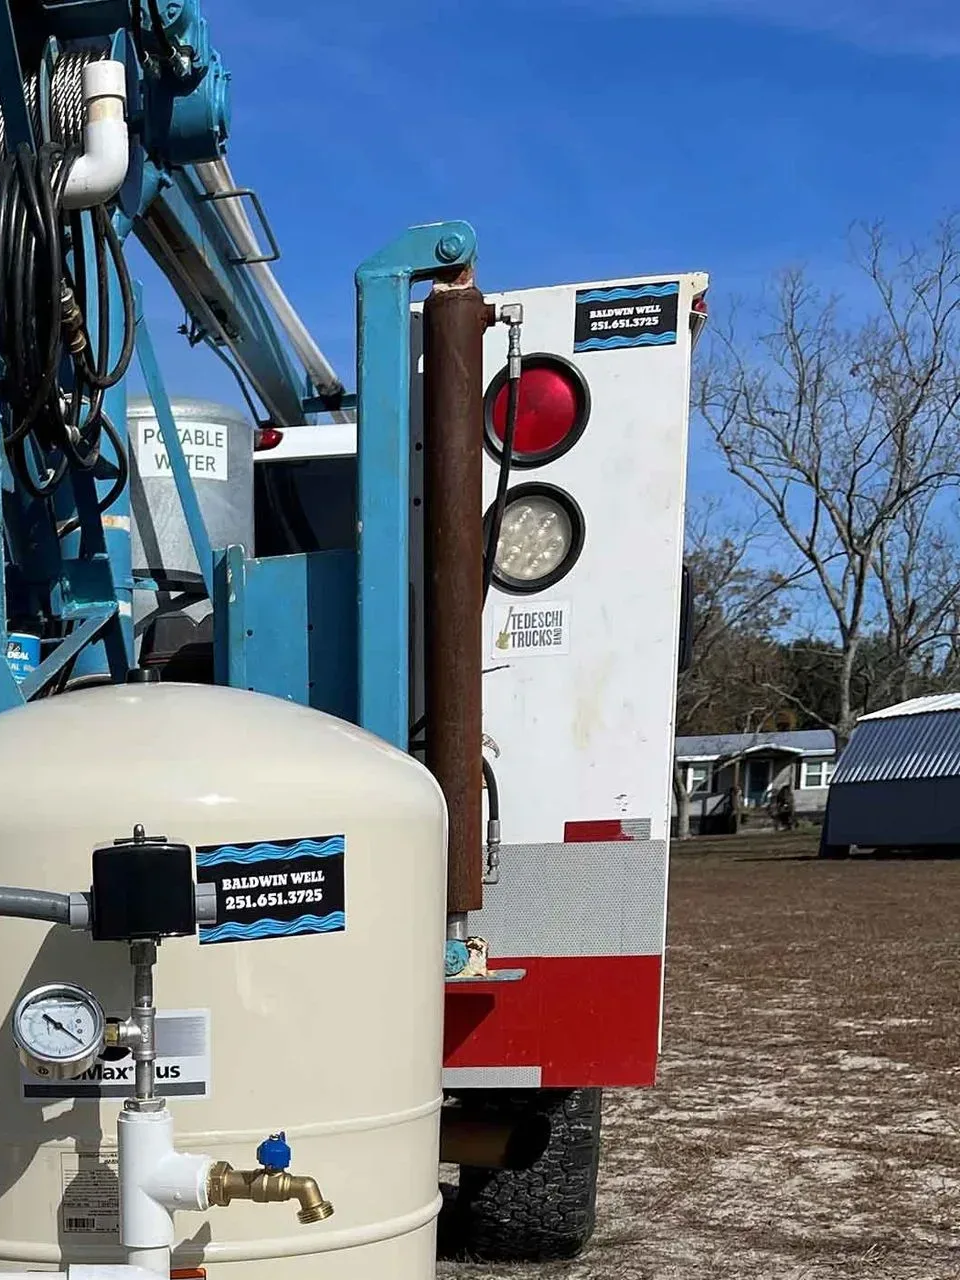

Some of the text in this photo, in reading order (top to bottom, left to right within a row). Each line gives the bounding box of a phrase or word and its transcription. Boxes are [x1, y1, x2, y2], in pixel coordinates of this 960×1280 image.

[590, 305, 661, 318] BALDWIN WELL
[591, 317, 659, 331] 251.651.3725
[144, 428, 224, 448] PABLE
[154, 454, 216, 473] WTER
[511, 610, 563, 630] TEDESCHI
[511, 629, 552, 648] TRUCKS
[553, 628, 562, 645] BAND
[222, 870, 325, 891] BALDWIN WELL
[225, 888, 323, 910] 251.651.3725
[71, 1065, 130, 1081] Max
